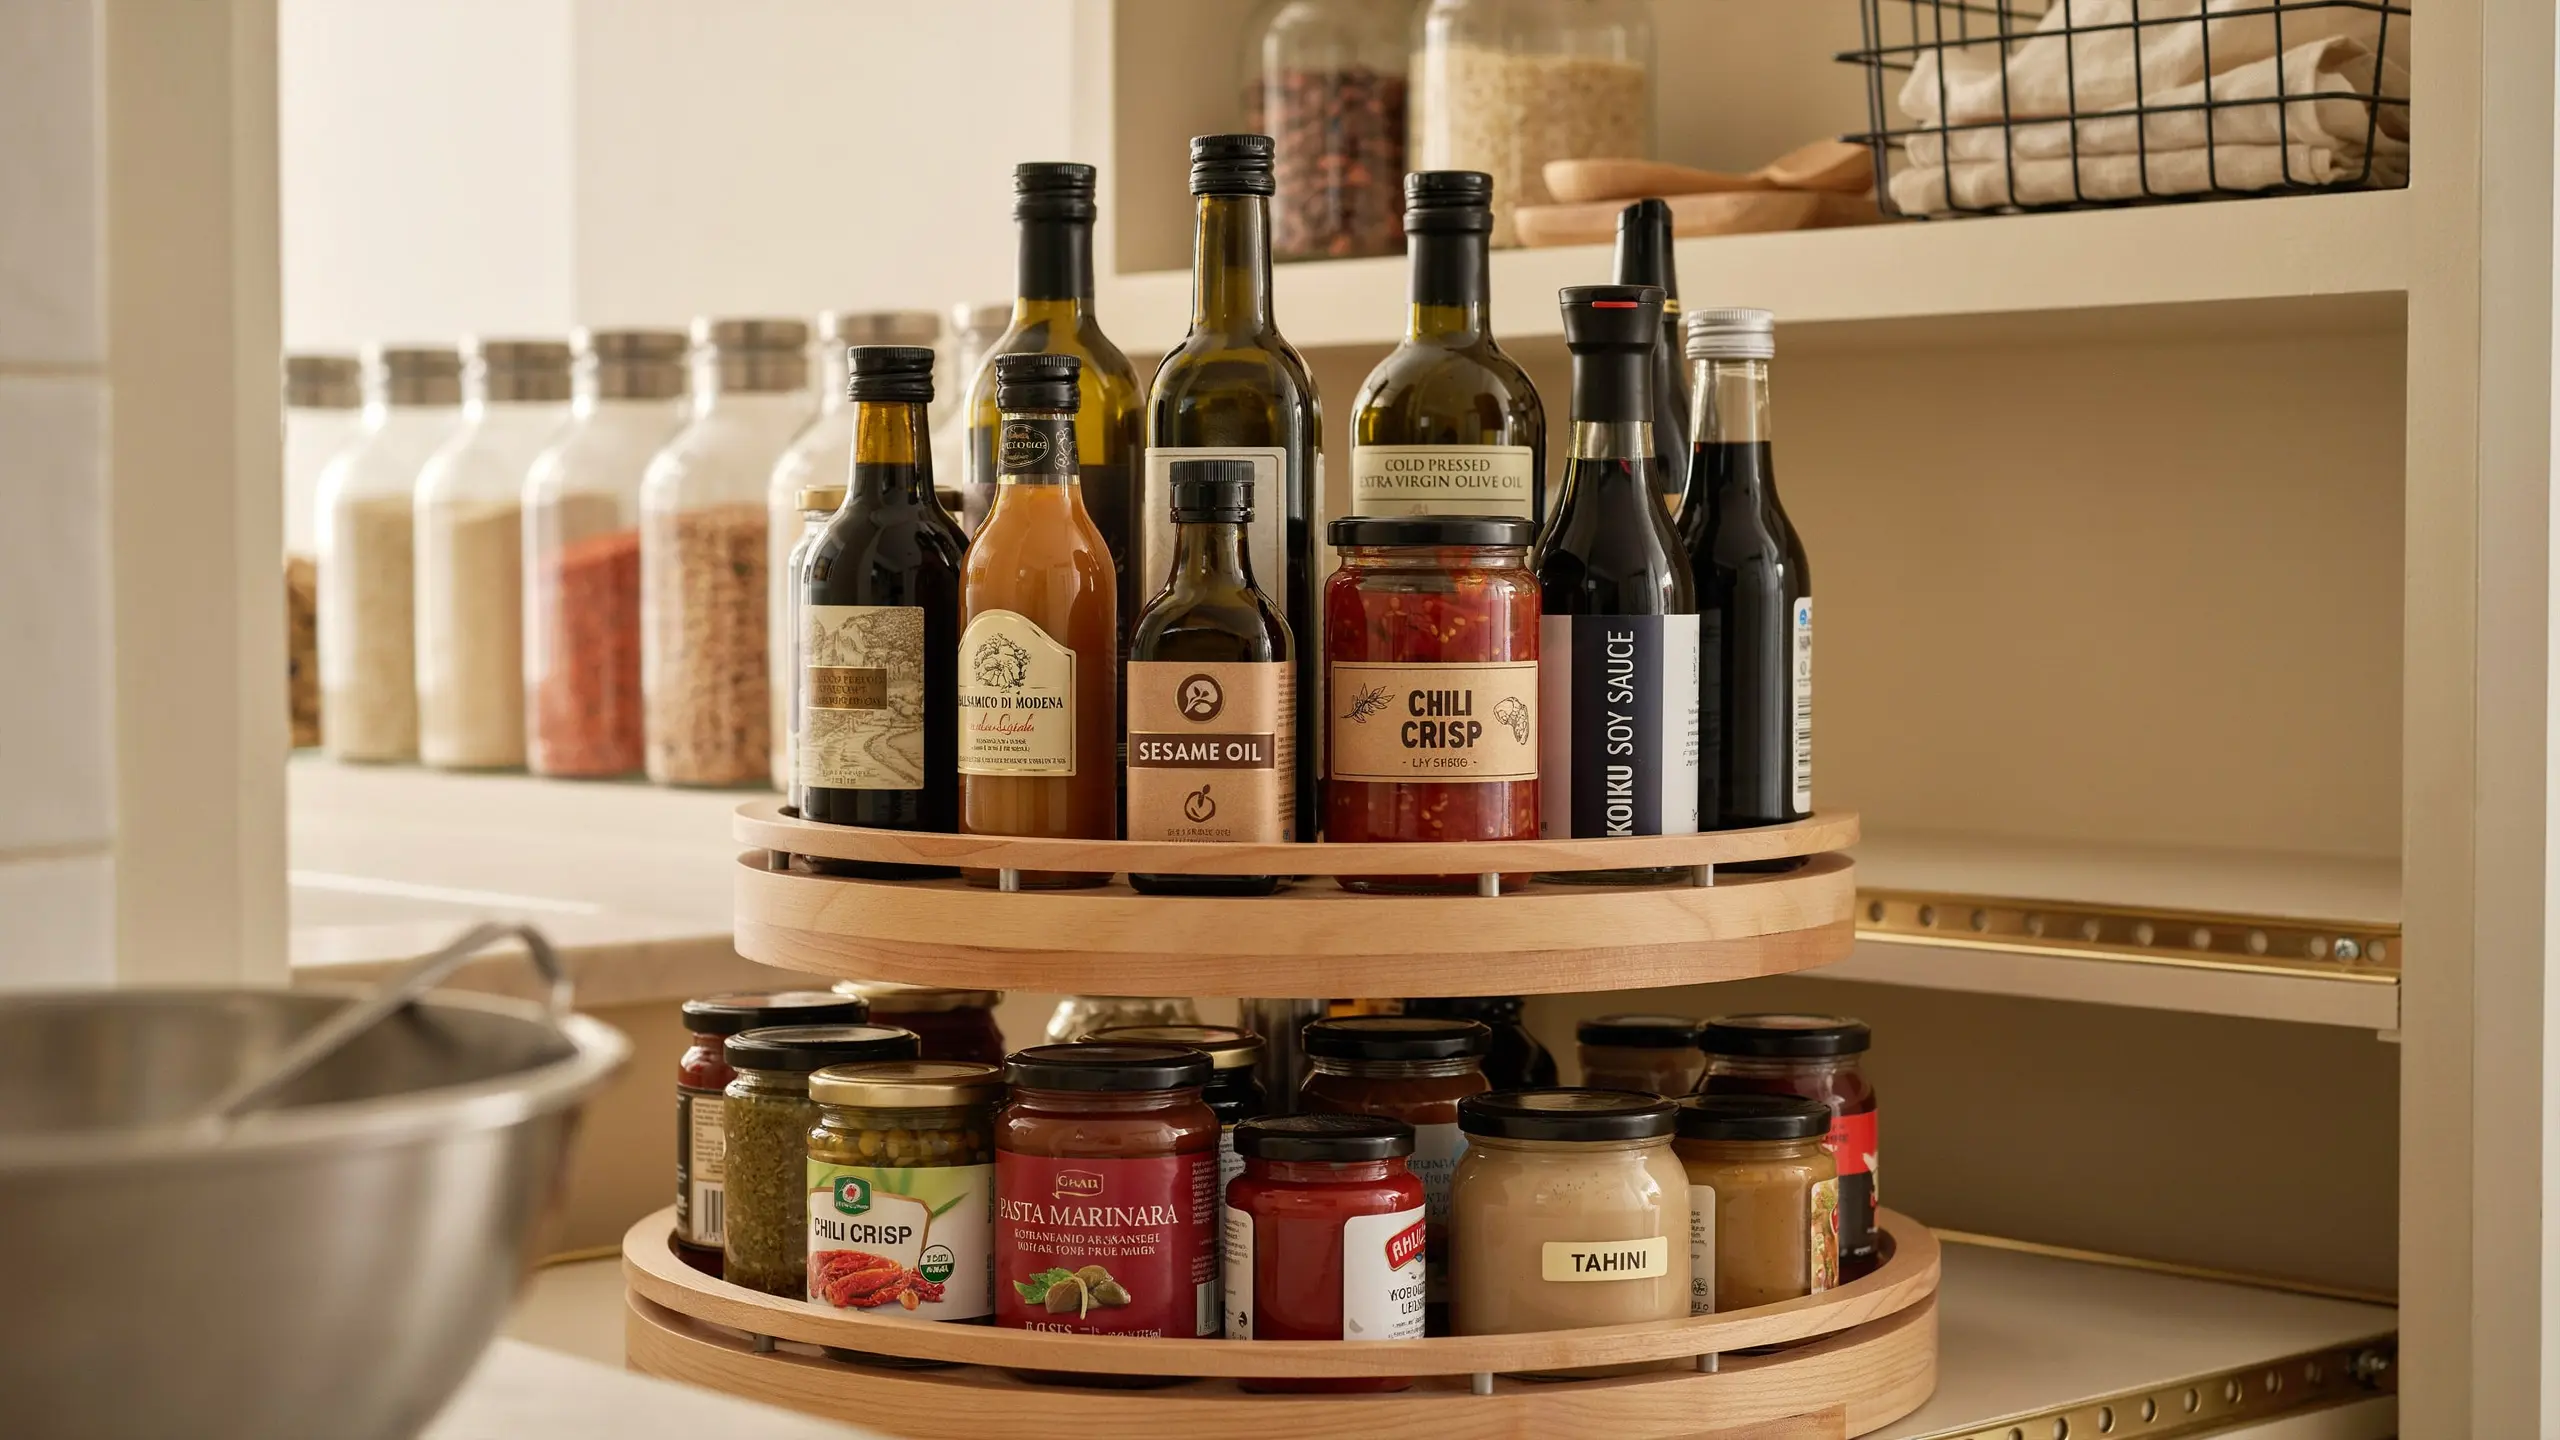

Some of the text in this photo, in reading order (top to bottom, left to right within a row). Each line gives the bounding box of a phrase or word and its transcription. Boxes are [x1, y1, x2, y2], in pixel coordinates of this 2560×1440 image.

[1385, 459, 1490, 472] COLD PRESSED
[1359, 475, 1523, 488] EXTRA VIRGIN OLIVE OIL
[1001, 697, 1012, 709] DI
[1015, 696, 1064, 709] MODENA
[1408, 689, 1472, 717] CHILI
[1401, 720, 1483, 748] CRISP
[1606, 630, 1634, 836] KOIKU SOY SAUCE
[1139, 742, 1262, 761] SESAME OIL
[1000, 1197, 1044, 1225] PASTA
[1049, 1203, 1179, 1228] MARINARA
[814, 1217, 913, 1245] CHILI CRISP
[1571, 1250, 1647, 1272] TAHINI
